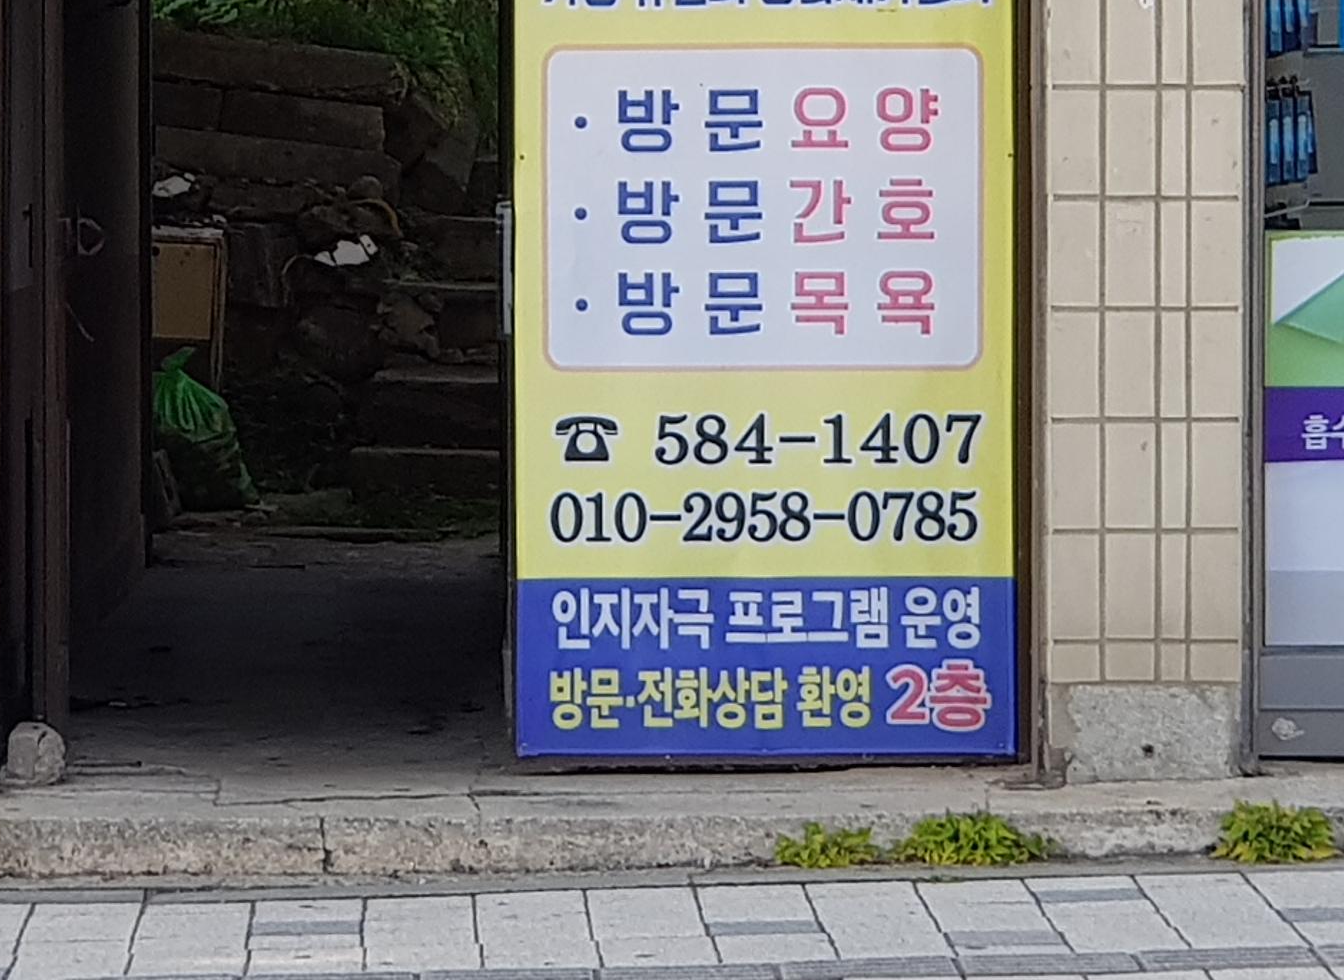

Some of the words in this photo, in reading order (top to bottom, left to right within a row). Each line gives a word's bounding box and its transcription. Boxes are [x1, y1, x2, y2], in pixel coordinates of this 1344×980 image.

[654, 413, 982, 465] 584-1407
[549, 490, 978, 543] 010-2958-0785
[551, 587, 715, 650] 인지자극
[725, 586, 889, 650] 프로그램
[901, 586, 981, 650] 운영
[797, 666, 871, 728] 환영
[886, 658, 990, 731] 2층
